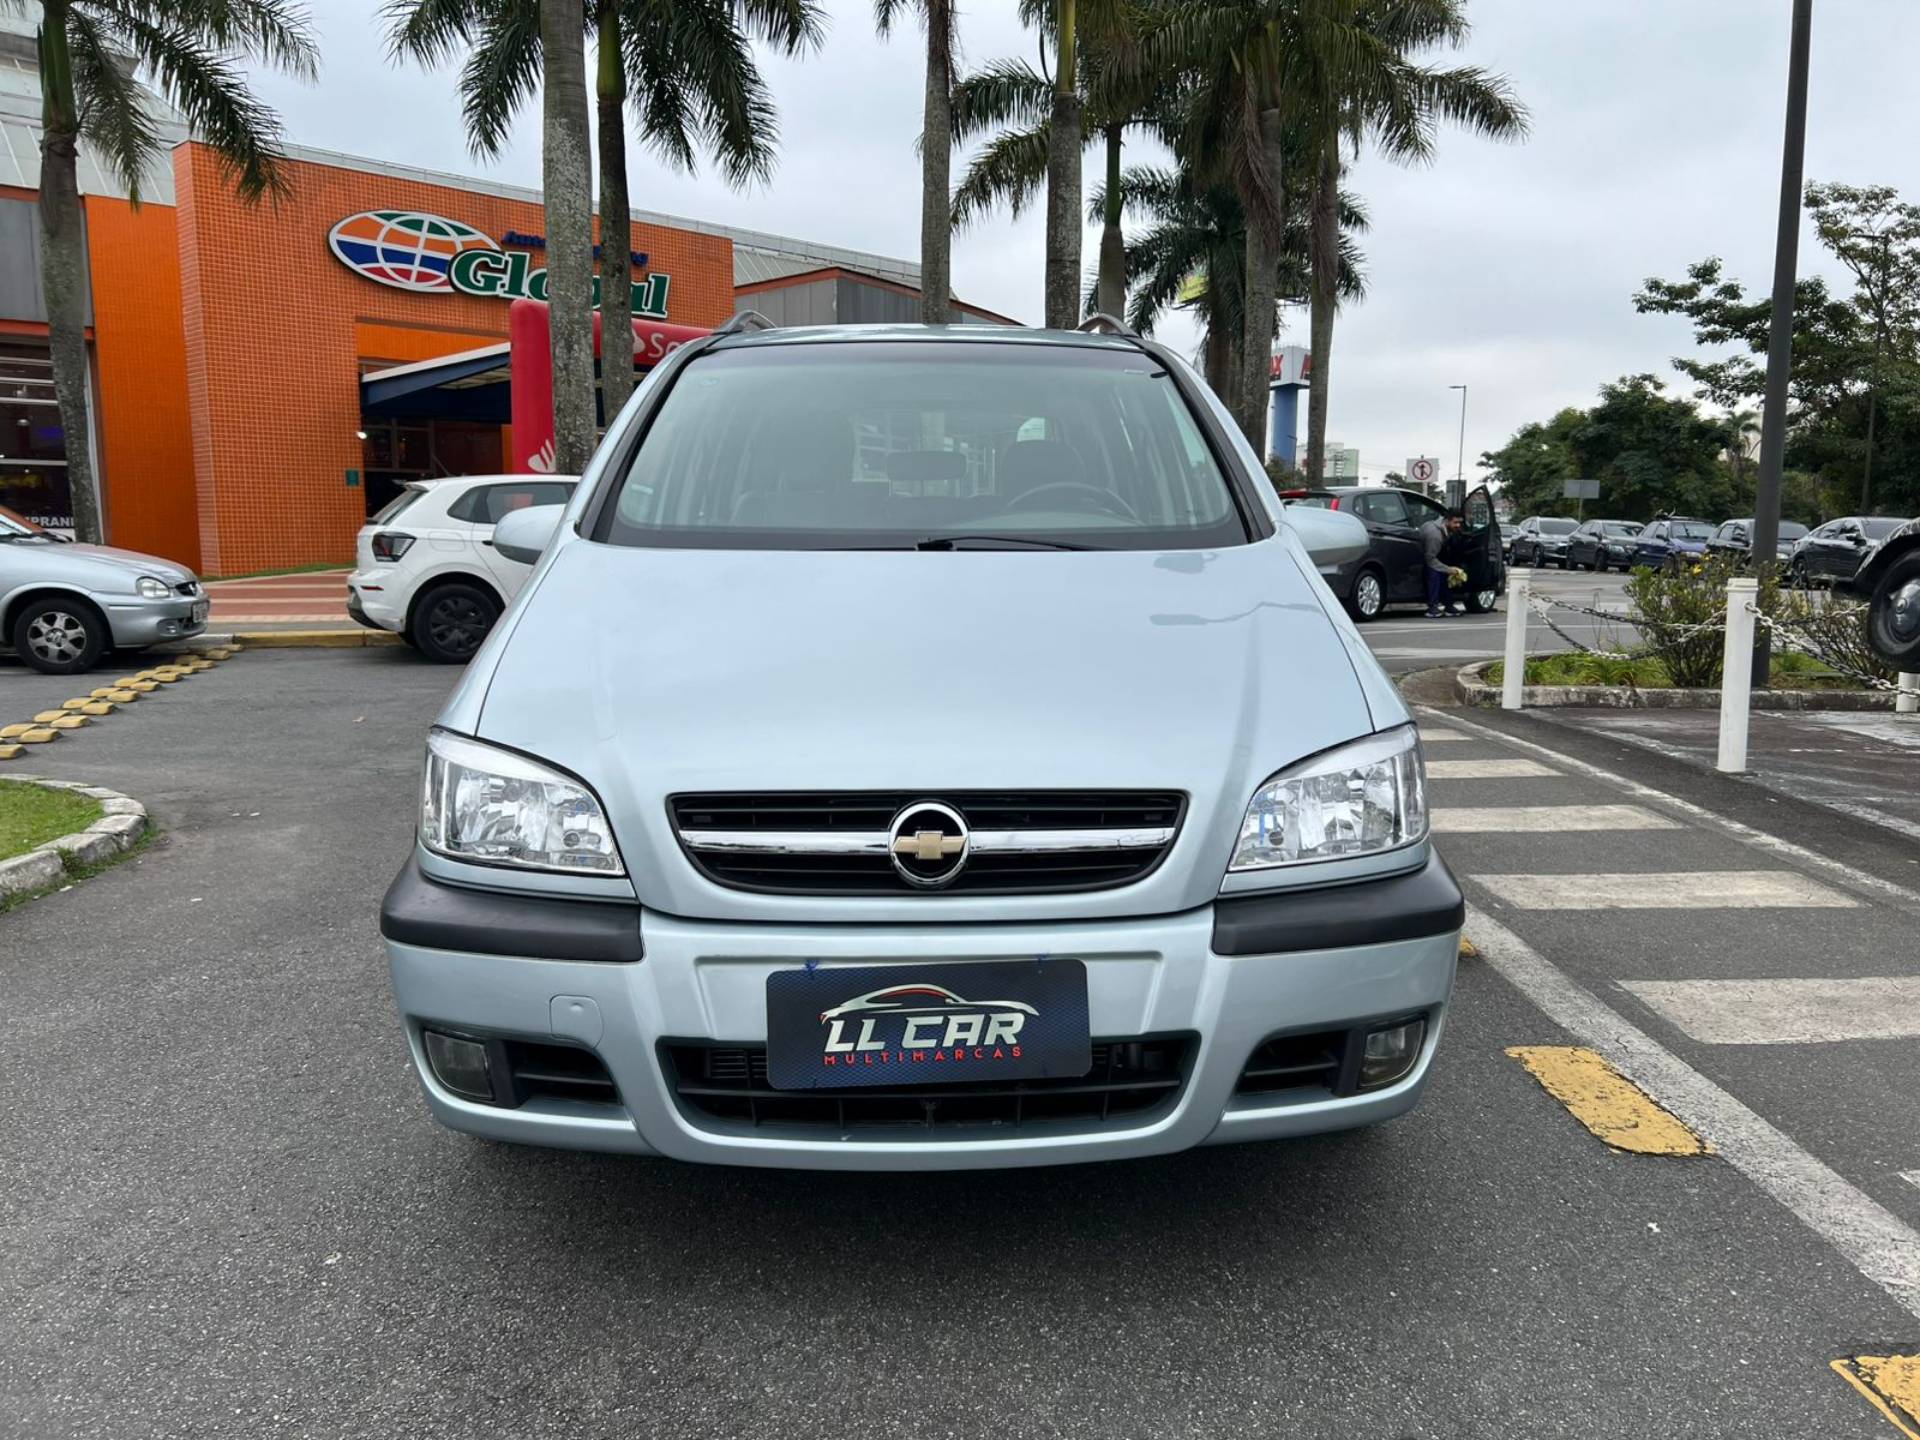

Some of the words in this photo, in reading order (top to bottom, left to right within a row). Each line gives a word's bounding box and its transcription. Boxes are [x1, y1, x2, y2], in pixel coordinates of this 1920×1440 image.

[451, 250, 671, 318] Glol
[824, 1019, 886, 1052] LL
[902, 1013, 1025, 1048] CAR
[824, 1047, 1023, 1066] MULTIMARCAS
